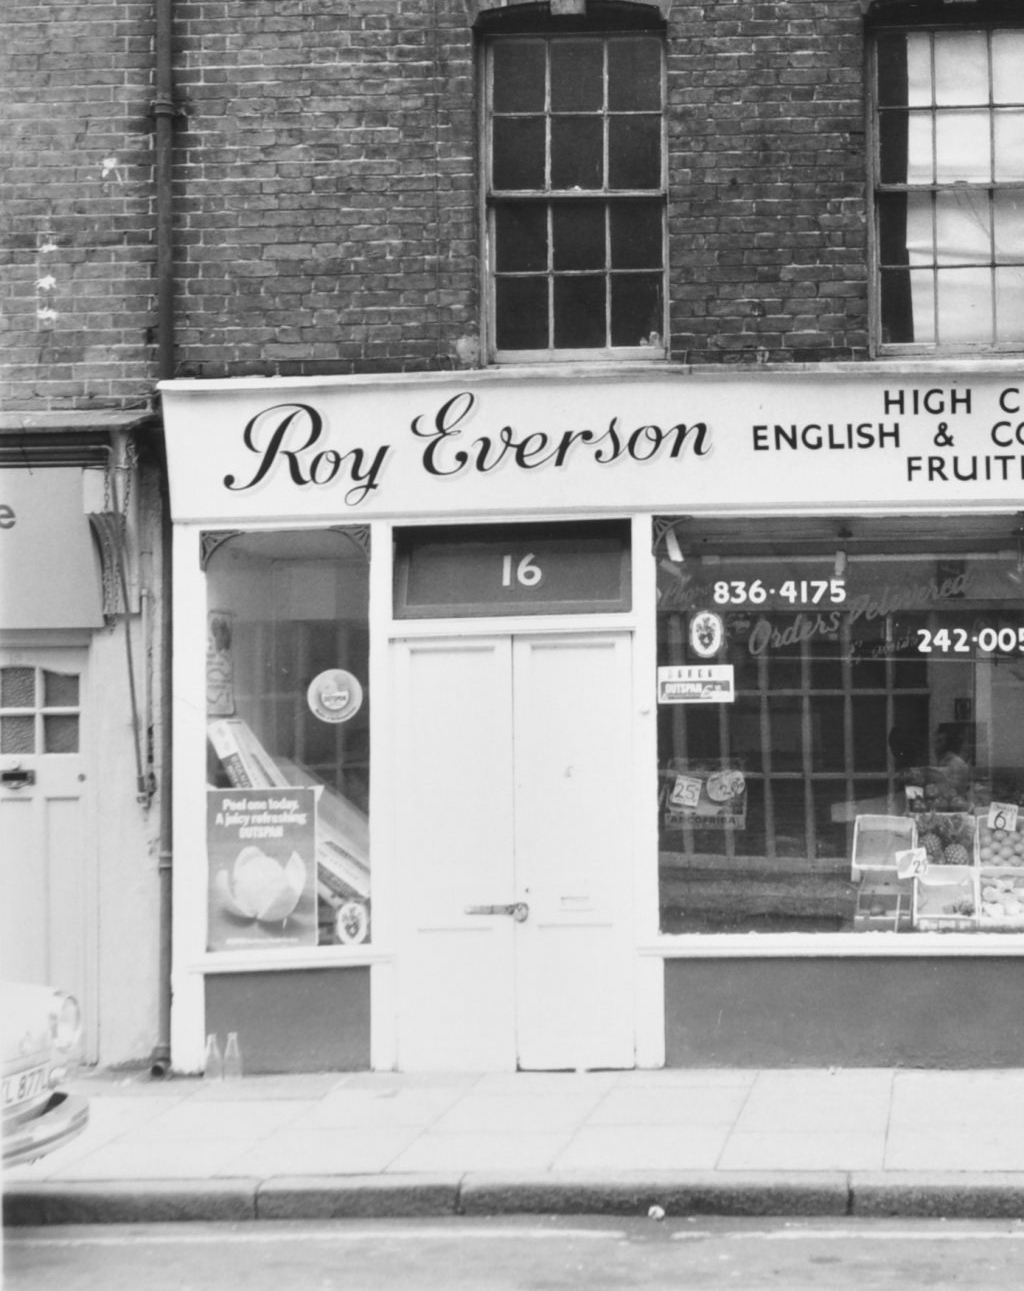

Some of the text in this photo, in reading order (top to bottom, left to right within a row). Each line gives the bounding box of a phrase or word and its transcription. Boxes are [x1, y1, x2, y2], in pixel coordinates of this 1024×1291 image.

[883, 388, 972, 415] HIGH
[224, 392, 714, 507] Roy Everson
[752, 422, 902, 451] ENGLISH
[933, 421, 955, 448] &
[502, 554, 543, 588] 16
[749, 611, 841, 655] Orders
[215, 812, 224, 825] A
